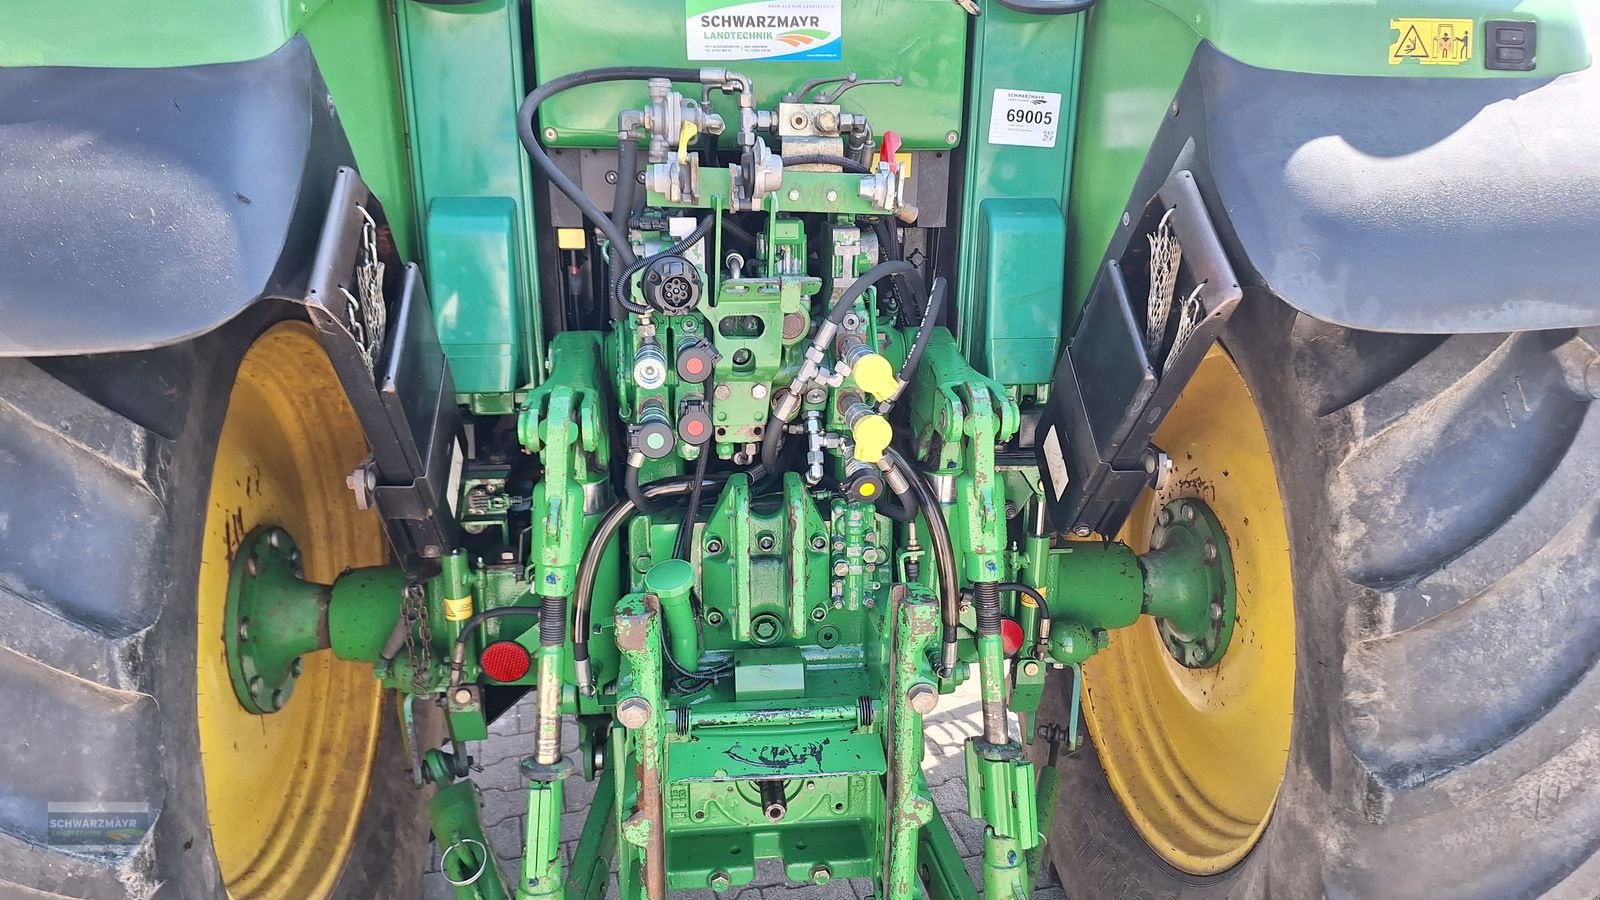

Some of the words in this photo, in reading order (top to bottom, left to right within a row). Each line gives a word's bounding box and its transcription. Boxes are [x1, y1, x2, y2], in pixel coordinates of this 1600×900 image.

[701, 15, 819, 28] SCHWARZMAYR
[703, 31, 773, 40] LANDTECHNIK
[1006, 108, 1052, 125] 69005
